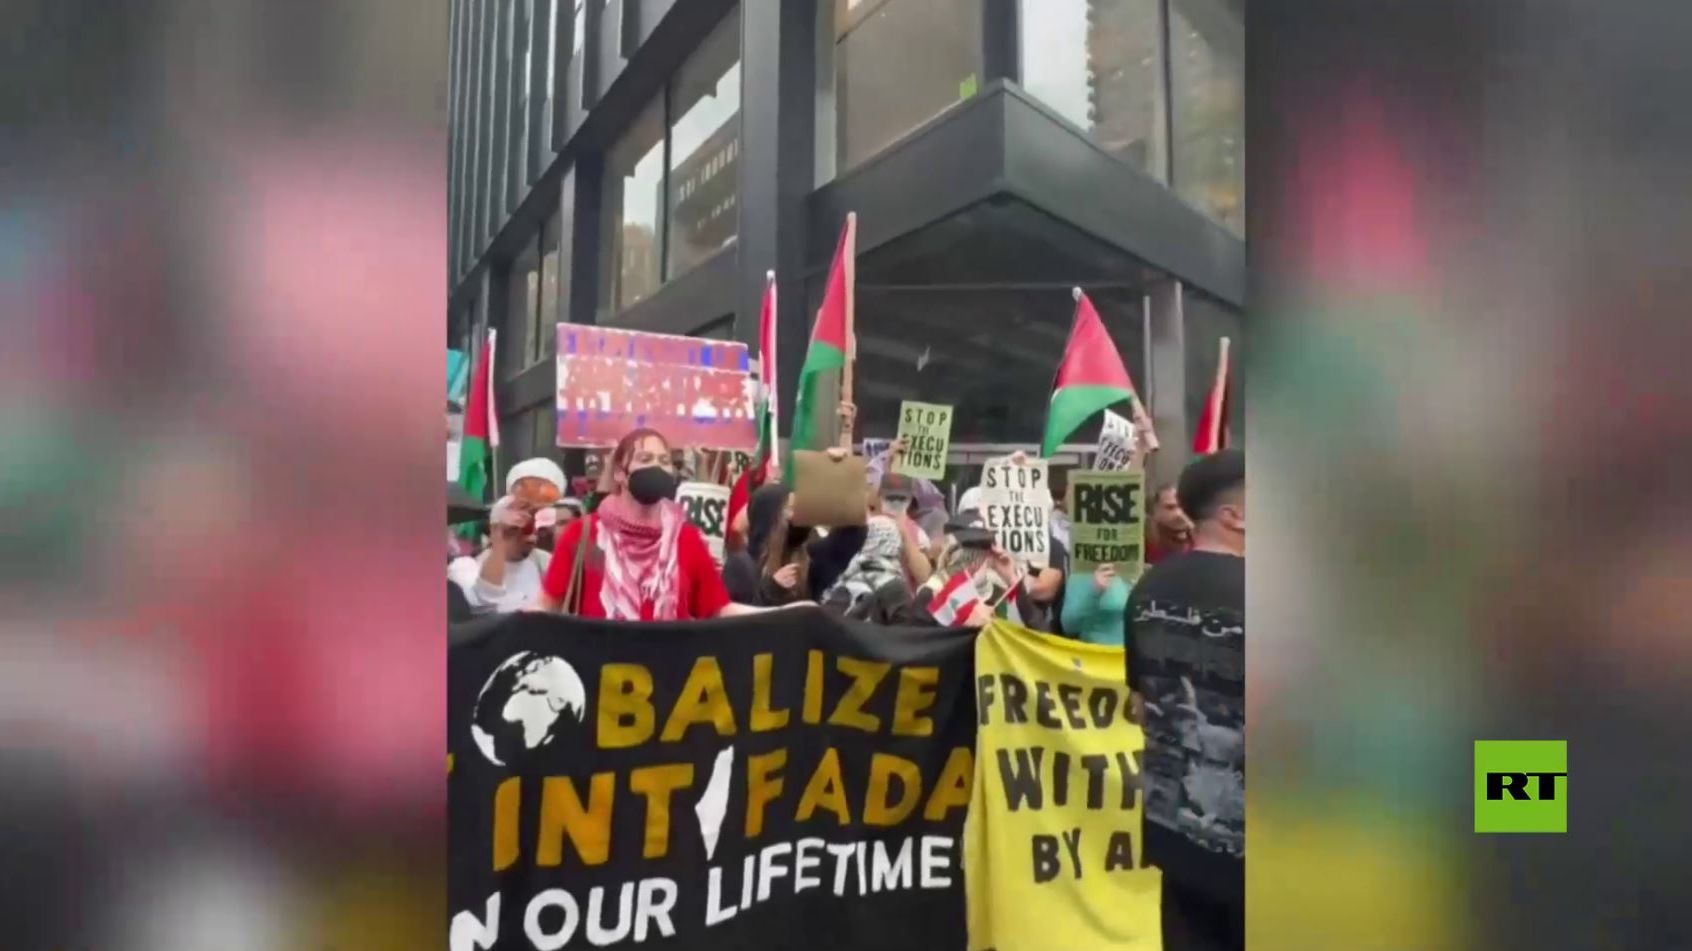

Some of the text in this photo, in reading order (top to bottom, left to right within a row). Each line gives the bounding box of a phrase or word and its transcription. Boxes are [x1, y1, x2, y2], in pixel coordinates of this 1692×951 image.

[905, 408, 947, 426] STOP
[987, 466, 1041, 488] STOP
[1009, 491, 1024, 502] THE
[1074, 483, 1141, 523] RISE
[988, 505, 1043, 528] EXECU
[1097, 528, 1118, 541] FOR
[1074, 543, 1140, 562] FREEDOM
[597, 649, 939, 749] BALIZE
[1031, 828, 1156, 883] BY A
[523, 878, 678, 950] OUR
[706, 836, 954, 927] LIFETIME
